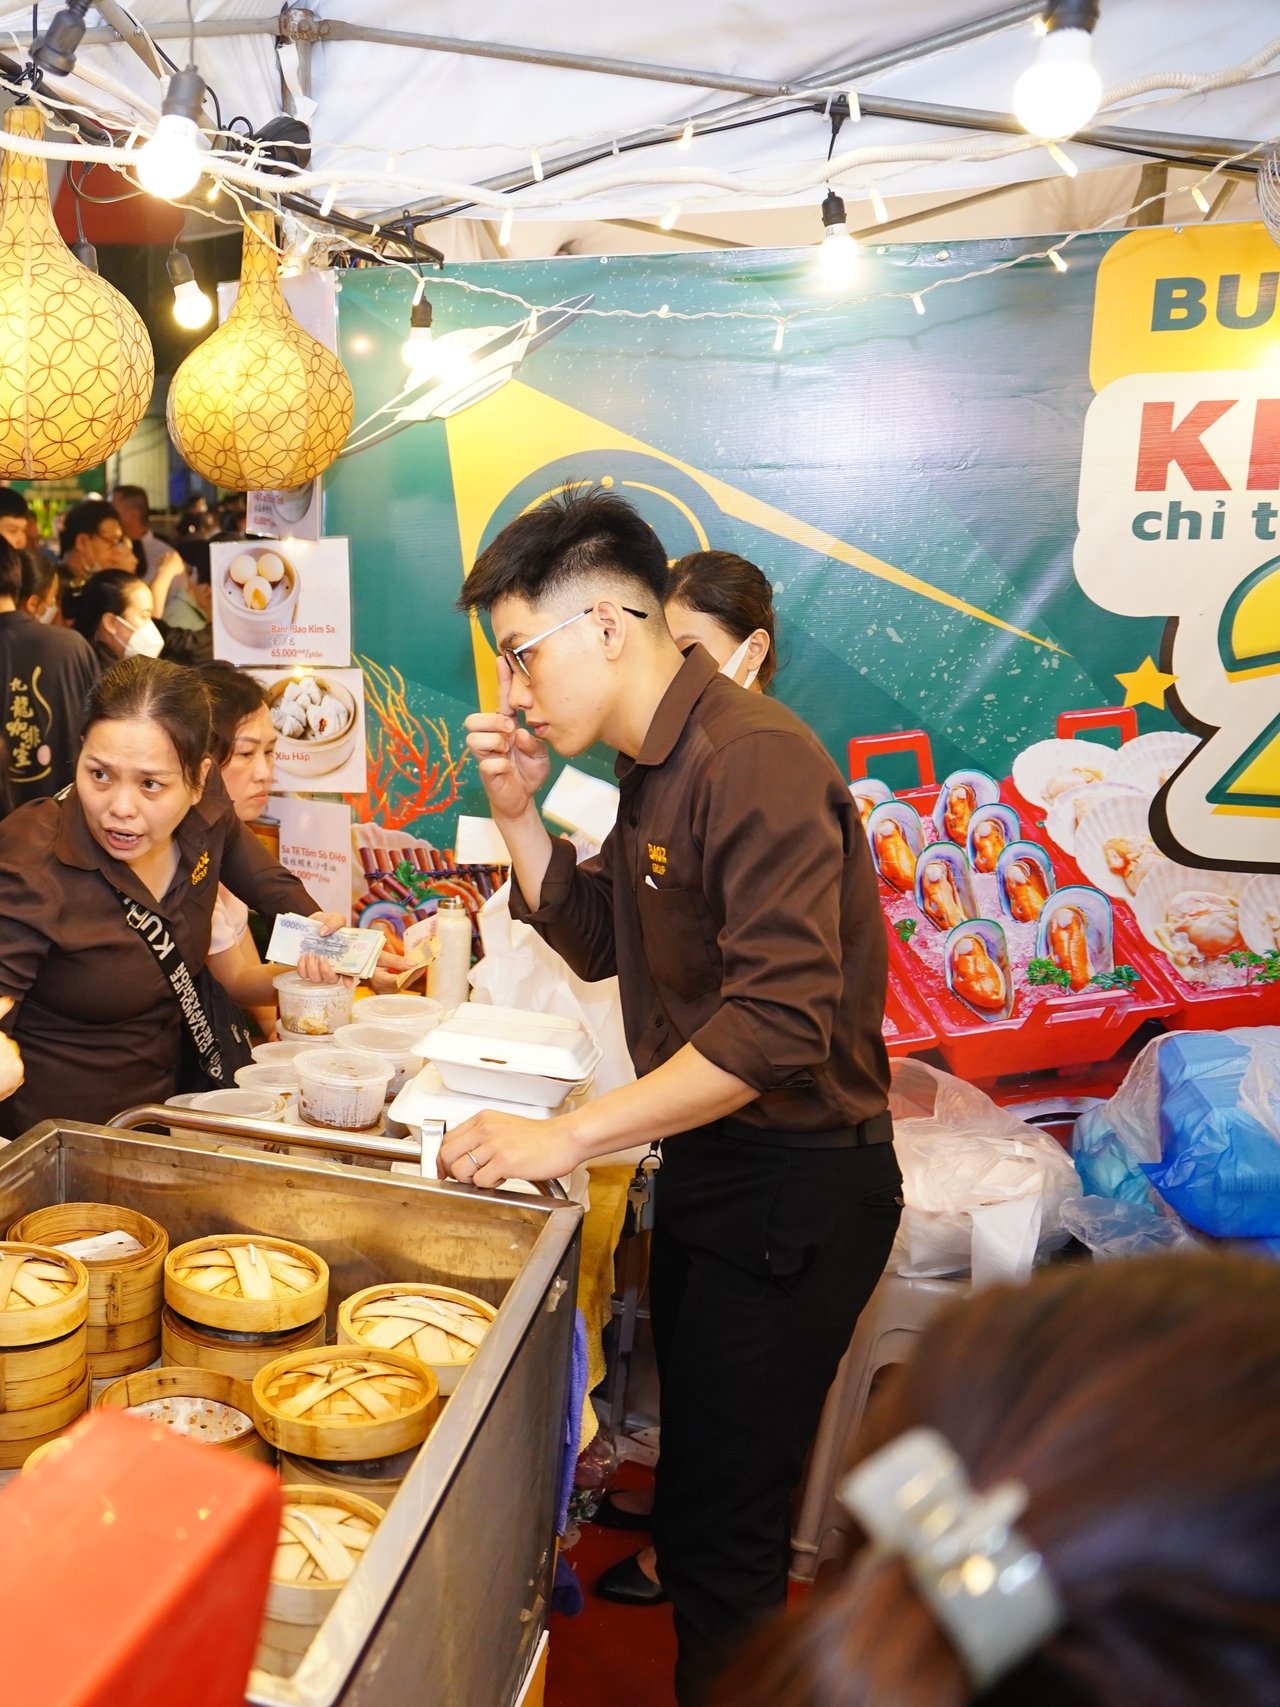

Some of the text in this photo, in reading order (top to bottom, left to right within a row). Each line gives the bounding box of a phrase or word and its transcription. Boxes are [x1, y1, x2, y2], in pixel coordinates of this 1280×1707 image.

[1131, 500, 1226, 541] chỉ
[308, 625, 324, 633] Kim
[326, 625, 335, 633] Sa
